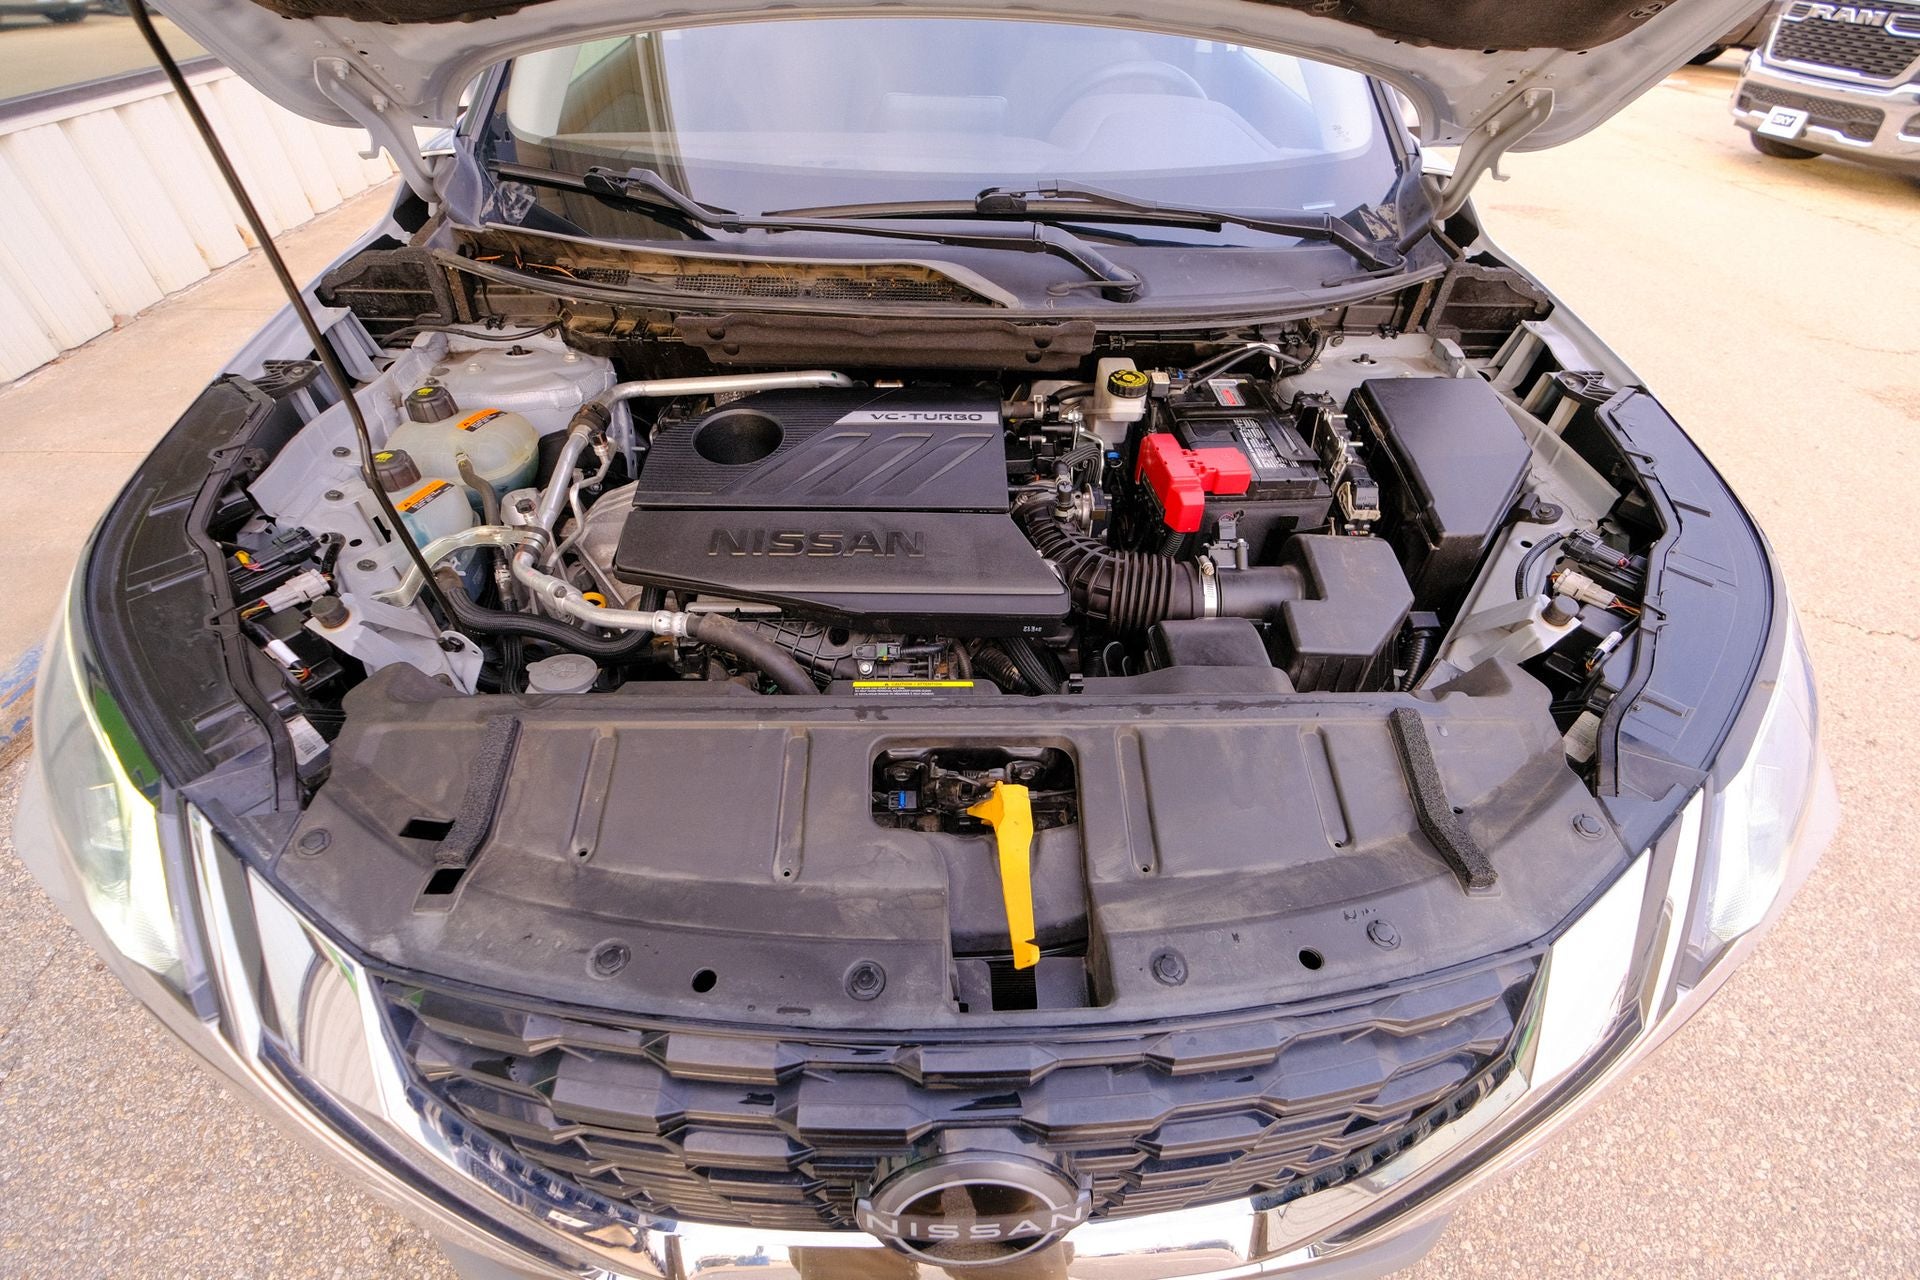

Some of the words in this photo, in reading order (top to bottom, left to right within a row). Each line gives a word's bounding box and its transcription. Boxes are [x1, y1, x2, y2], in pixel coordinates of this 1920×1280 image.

[1809, 3, 1889, 27] RAM
[871, 411, 983, 422] VC-TURBO
[707, 528, 926, 558] NISSAN
[867, 1206, 1082, 1240] NISSAN
